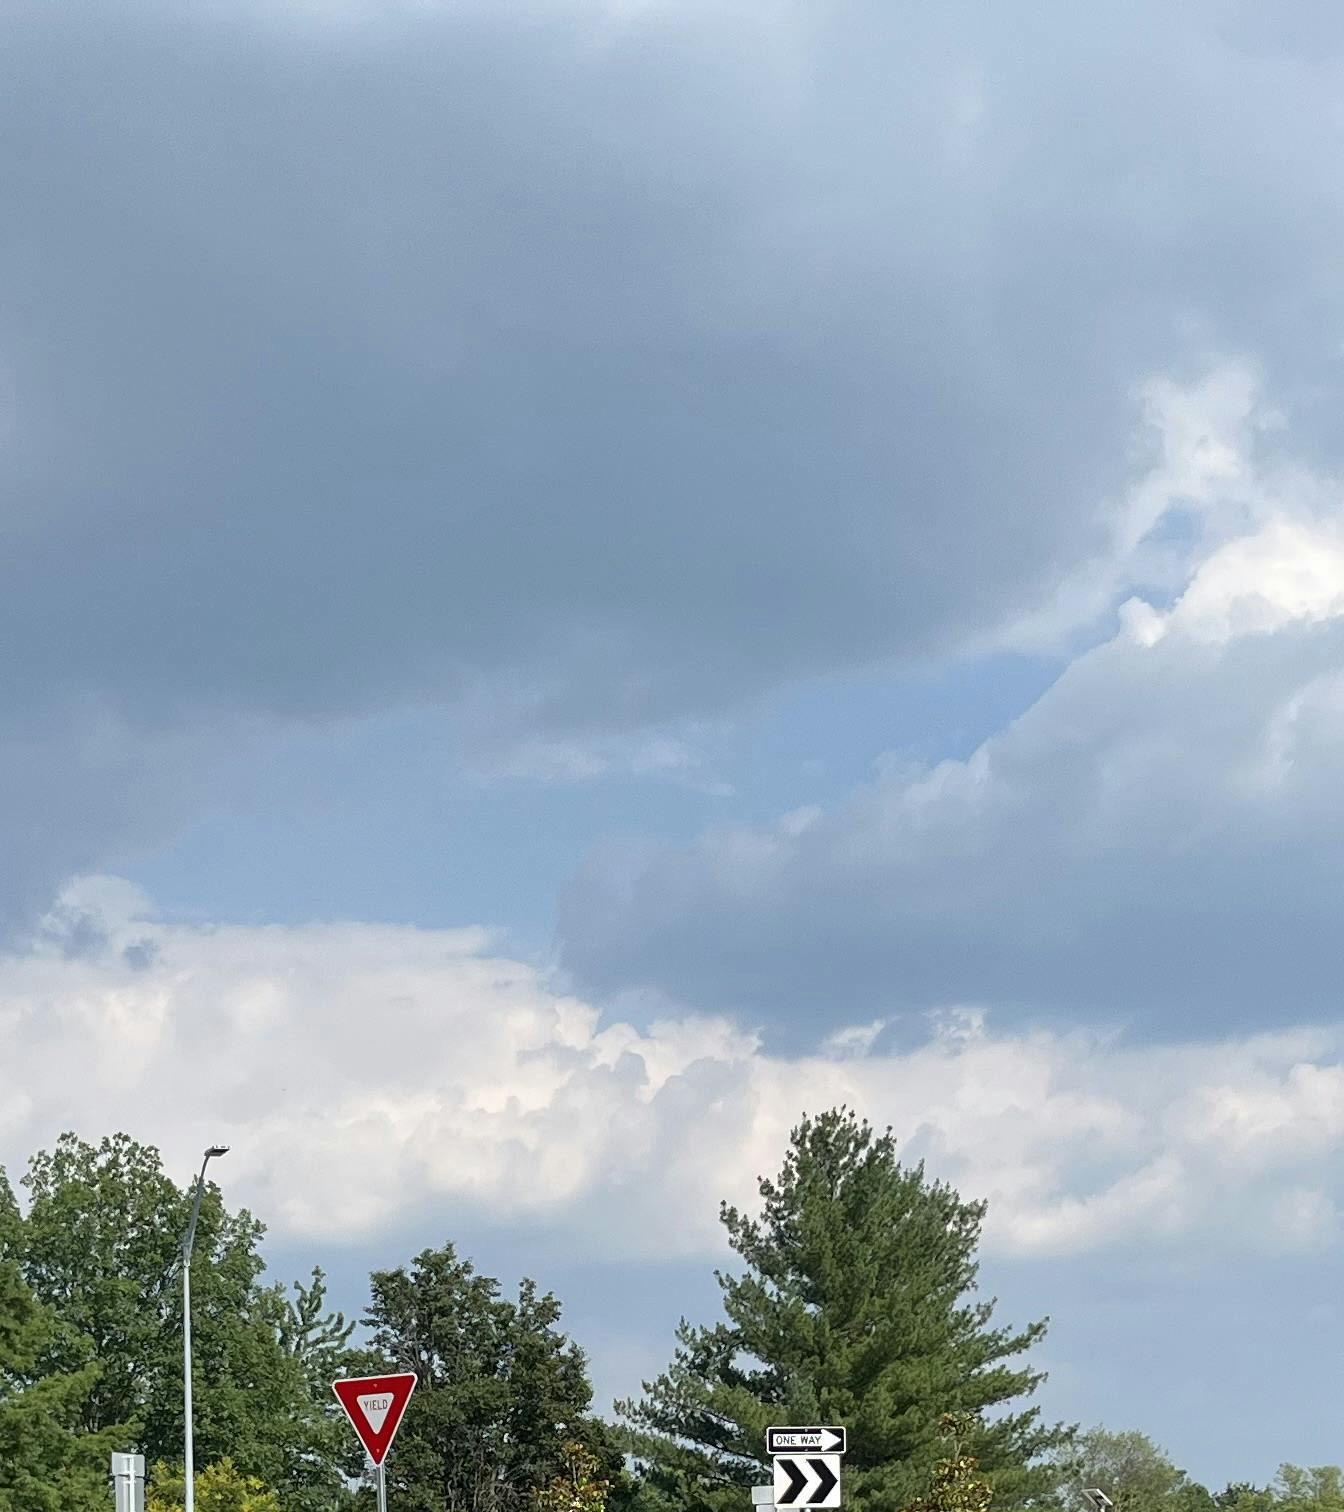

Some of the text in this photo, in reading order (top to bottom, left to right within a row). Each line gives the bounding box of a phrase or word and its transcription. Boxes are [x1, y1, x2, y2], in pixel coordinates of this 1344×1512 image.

[363, 1399, 388, 1411] YIELD
[776, 1435, 822, 1446] ONE WAY
